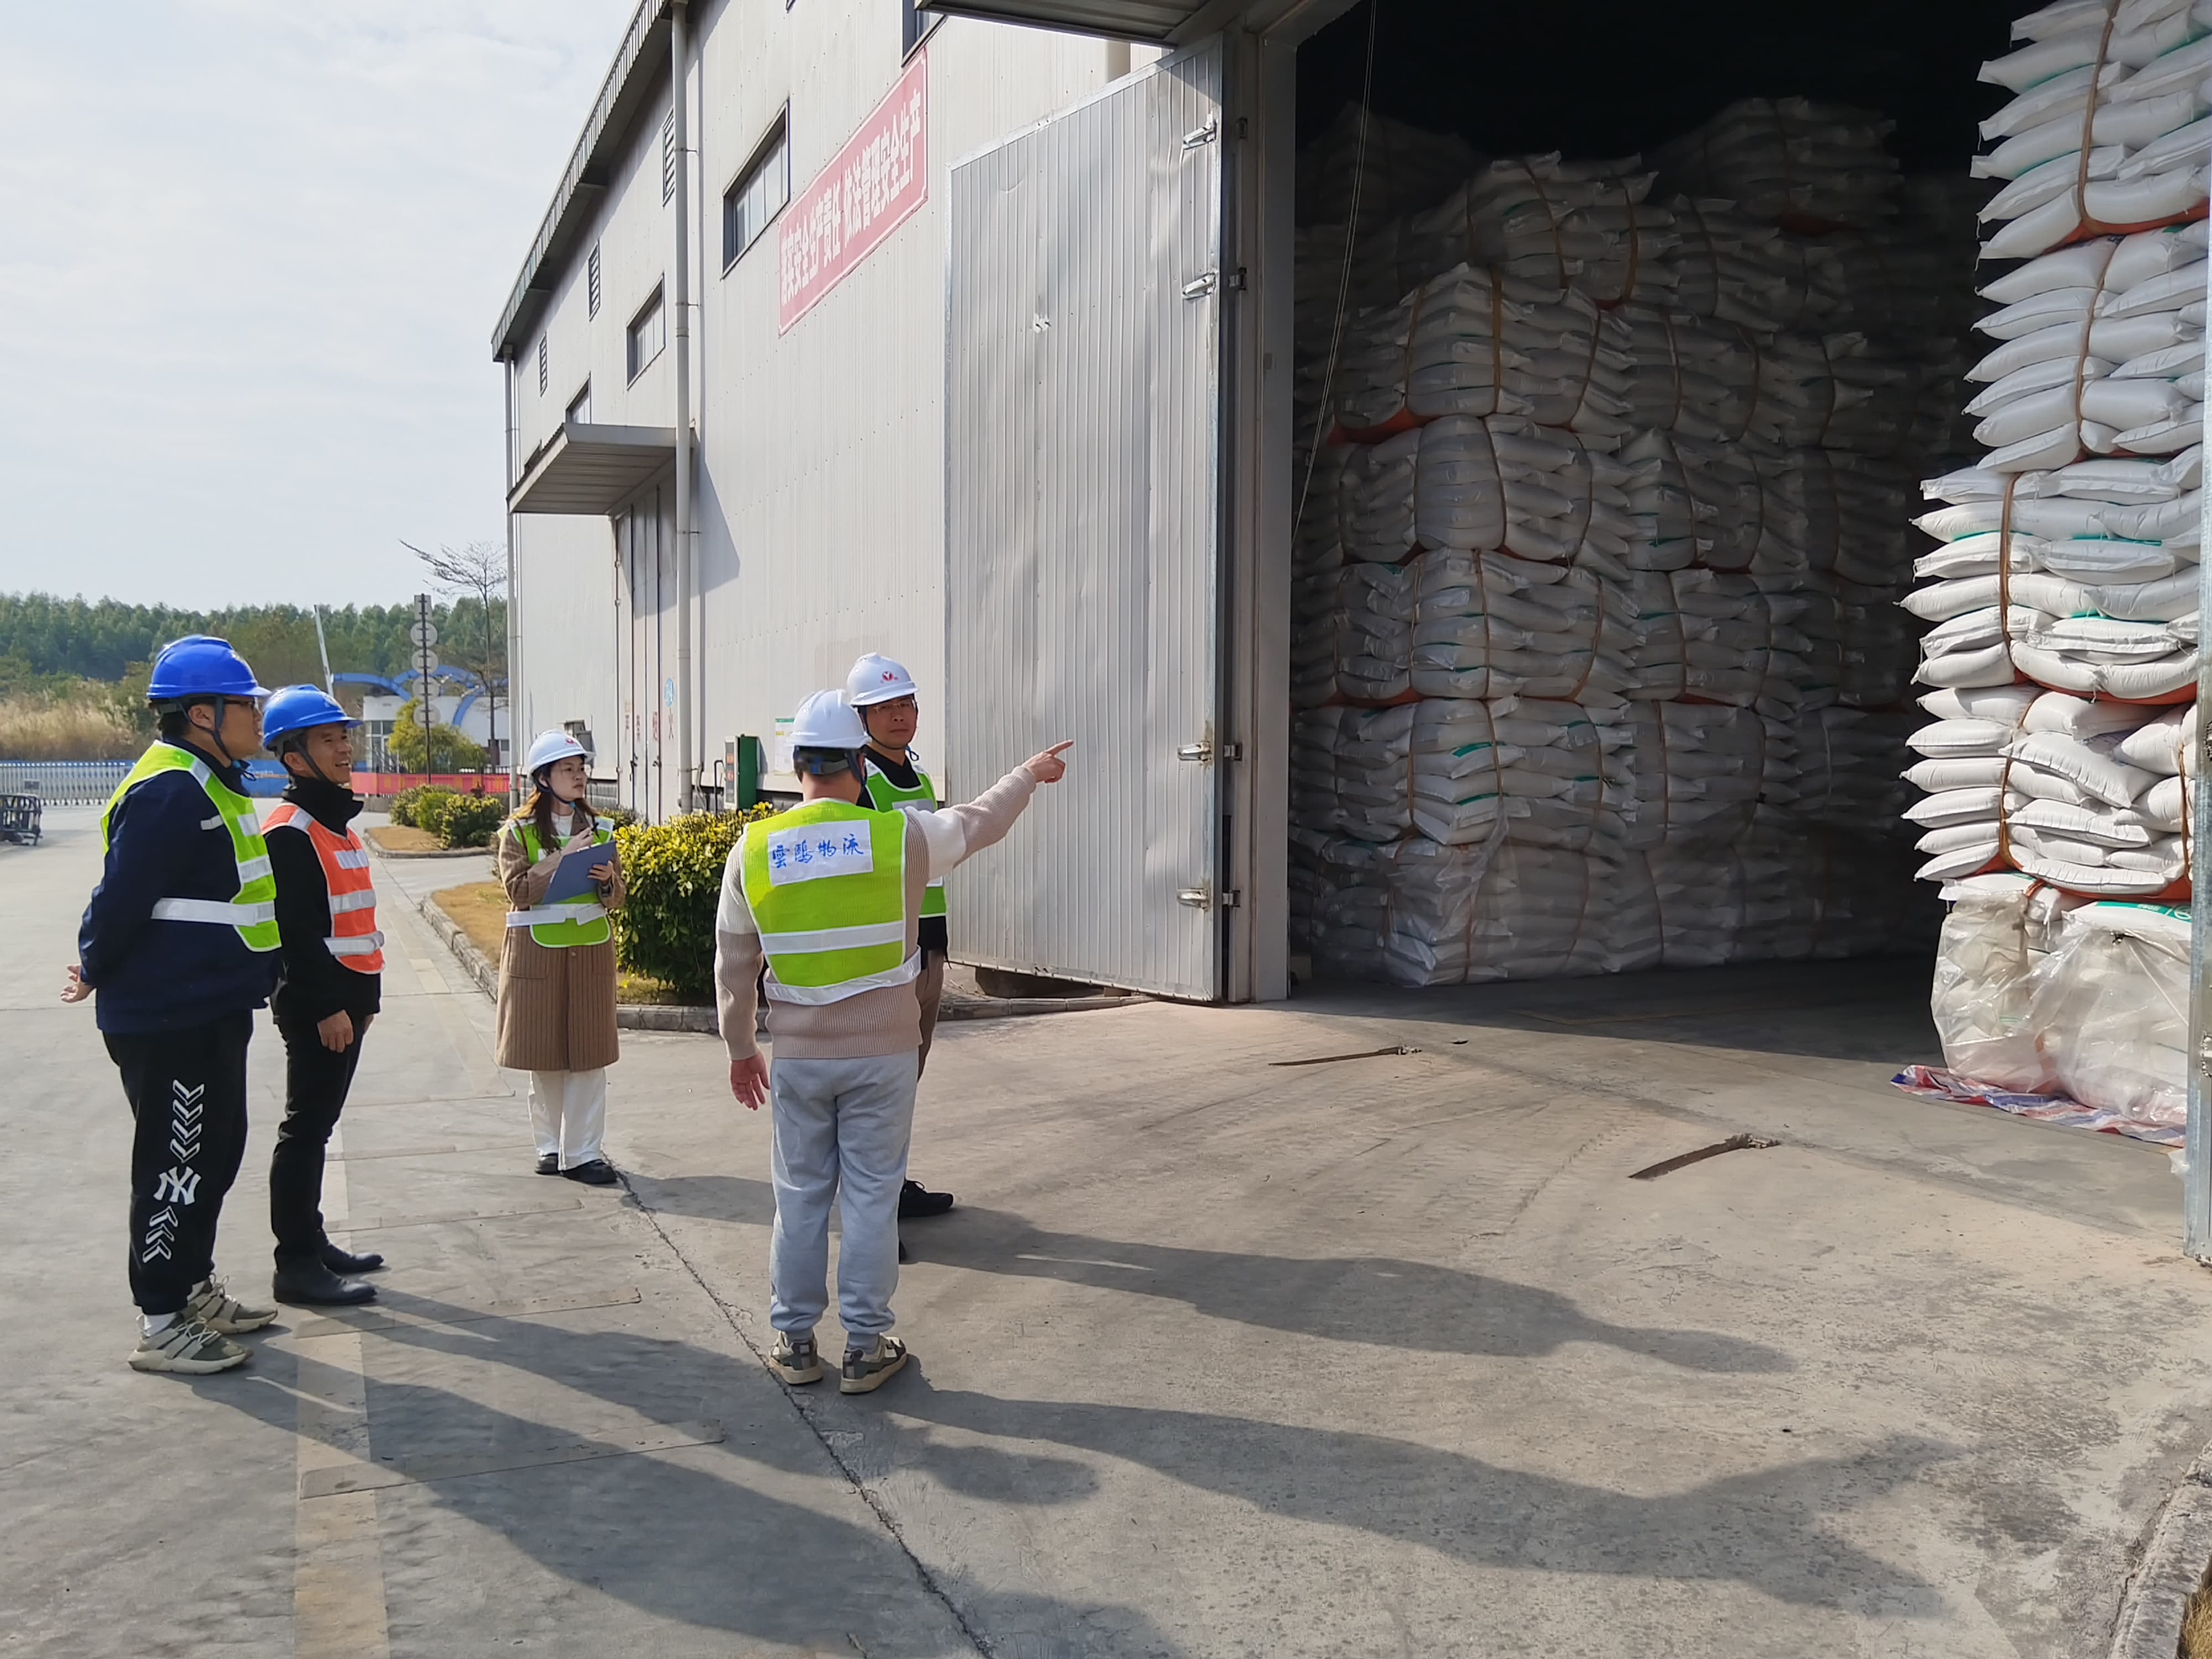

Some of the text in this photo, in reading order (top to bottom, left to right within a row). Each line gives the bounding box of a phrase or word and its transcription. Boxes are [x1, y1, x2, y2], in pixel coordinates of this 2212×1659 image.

[781, 89, 920, 305] 落实安全生产责任 依法管理安全生产
[153, 1166, 201, 1206] NY
